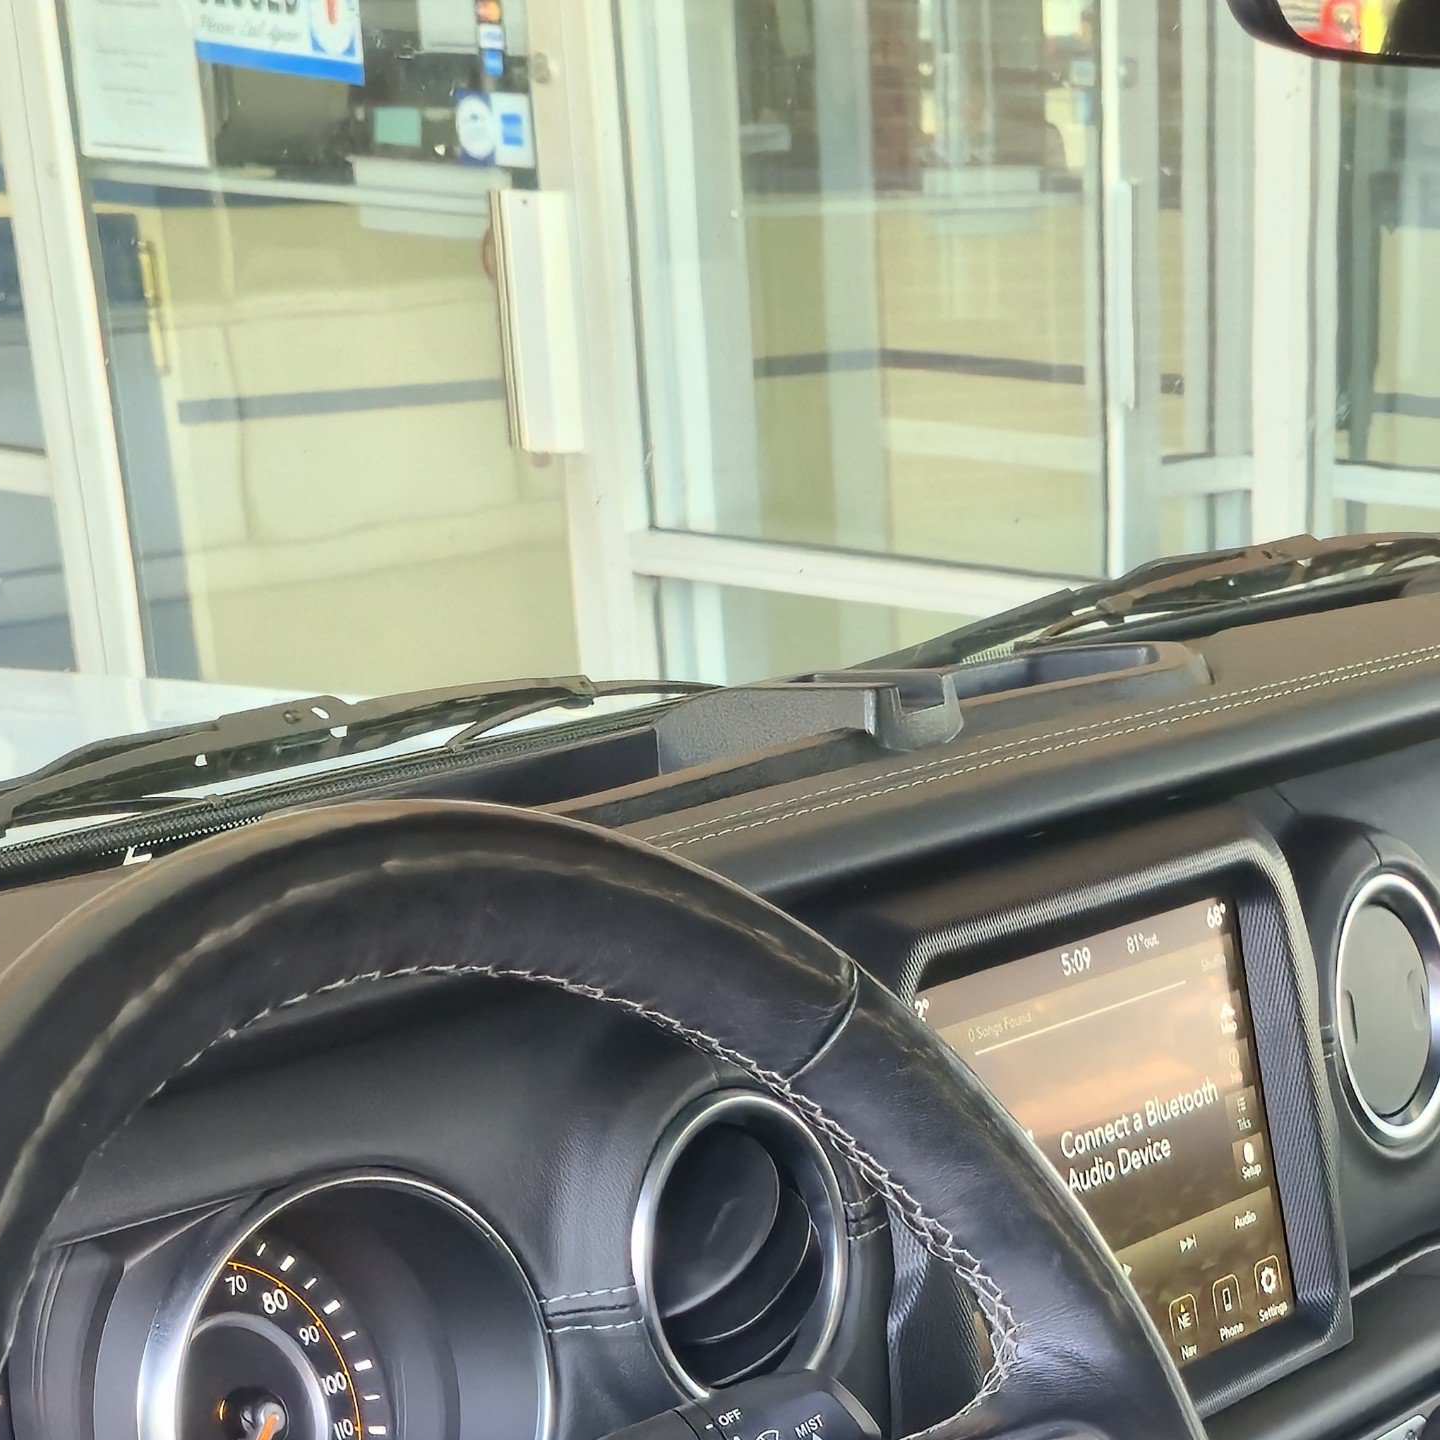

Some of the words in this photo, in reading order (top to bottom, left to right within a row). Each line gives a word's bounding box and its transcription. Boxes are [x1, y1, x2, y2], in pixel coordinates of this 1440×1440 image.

[1061, 946, 1092, 977] 5:09
[977, 1022, 1003, 1040] Songs
[1003, 1011, 1032, 1031] Found
[1061, 1115, 1130, 1159] Connect
[1133, 1112, 1144, 1132] a
[1145, 1077, 1219, 1126] Bluetooth
[1067, 1154, 1117, 1194] Audio
[1117, 1136, 1172, 1177] Device
[1241, 1162, 1262, 1181] Setup
[1234, 1210, 1258, 1231] Audio
[225, 1276, 247, 1296] 70
[262, 1288, 289, 1315] 80
[1258, 1300, 1288, 1324] Settings
[1177, 1312, 1192, 1331] NE
[1219, 1321, 1245, 1343] Phone
[298, 1325, 320, 1346] 90
[322, 1371, 347, 1396] 100
[334, 1418, 355, 1440] 110
[717, 1408, 742, 1427] OFF
[794, 1413, 825, 1439] MIST
